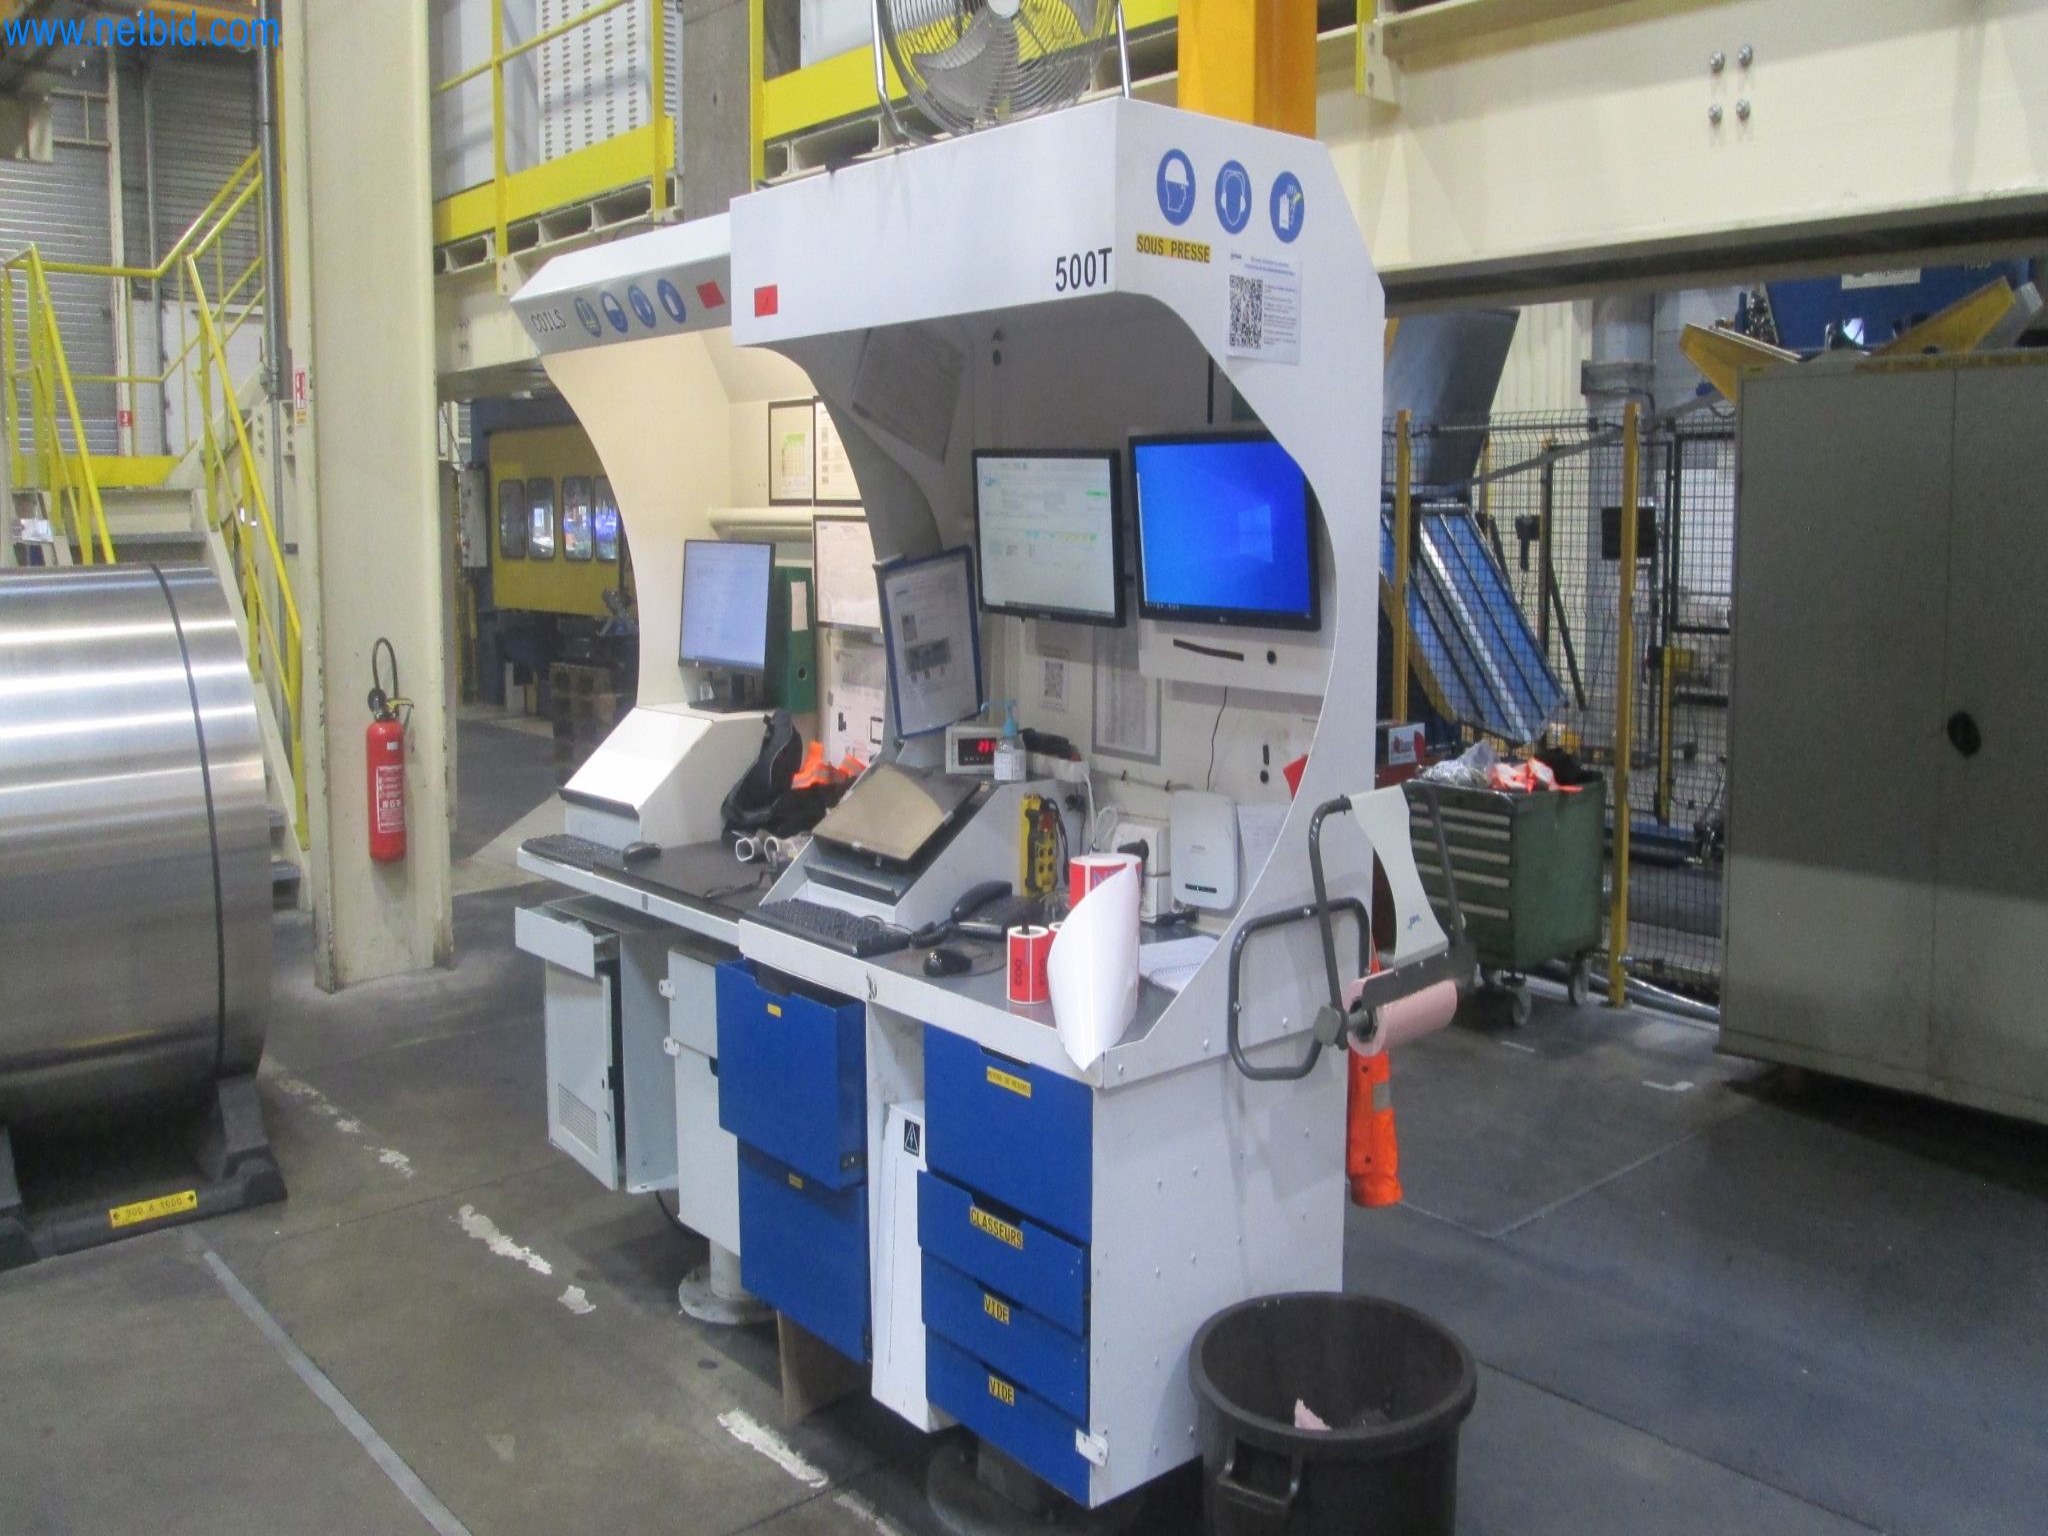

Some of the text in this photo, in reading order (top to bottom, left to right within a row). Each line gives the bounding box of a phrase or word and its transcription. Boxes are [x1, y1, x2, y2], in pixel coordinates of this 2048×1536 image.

[1136, 234, 1165, 256] SOUS
[1170, 240, 1211, 264] PRESSE
[1055, 246, 1113, 292] 500T
[530, 308, 568, 333] COILS
[970, 1208, 1022, 1248] CLASSEURS
[985, 1295, 1009, 1324] VIDE
[989, 1378, 1013, 1405] VIDE
